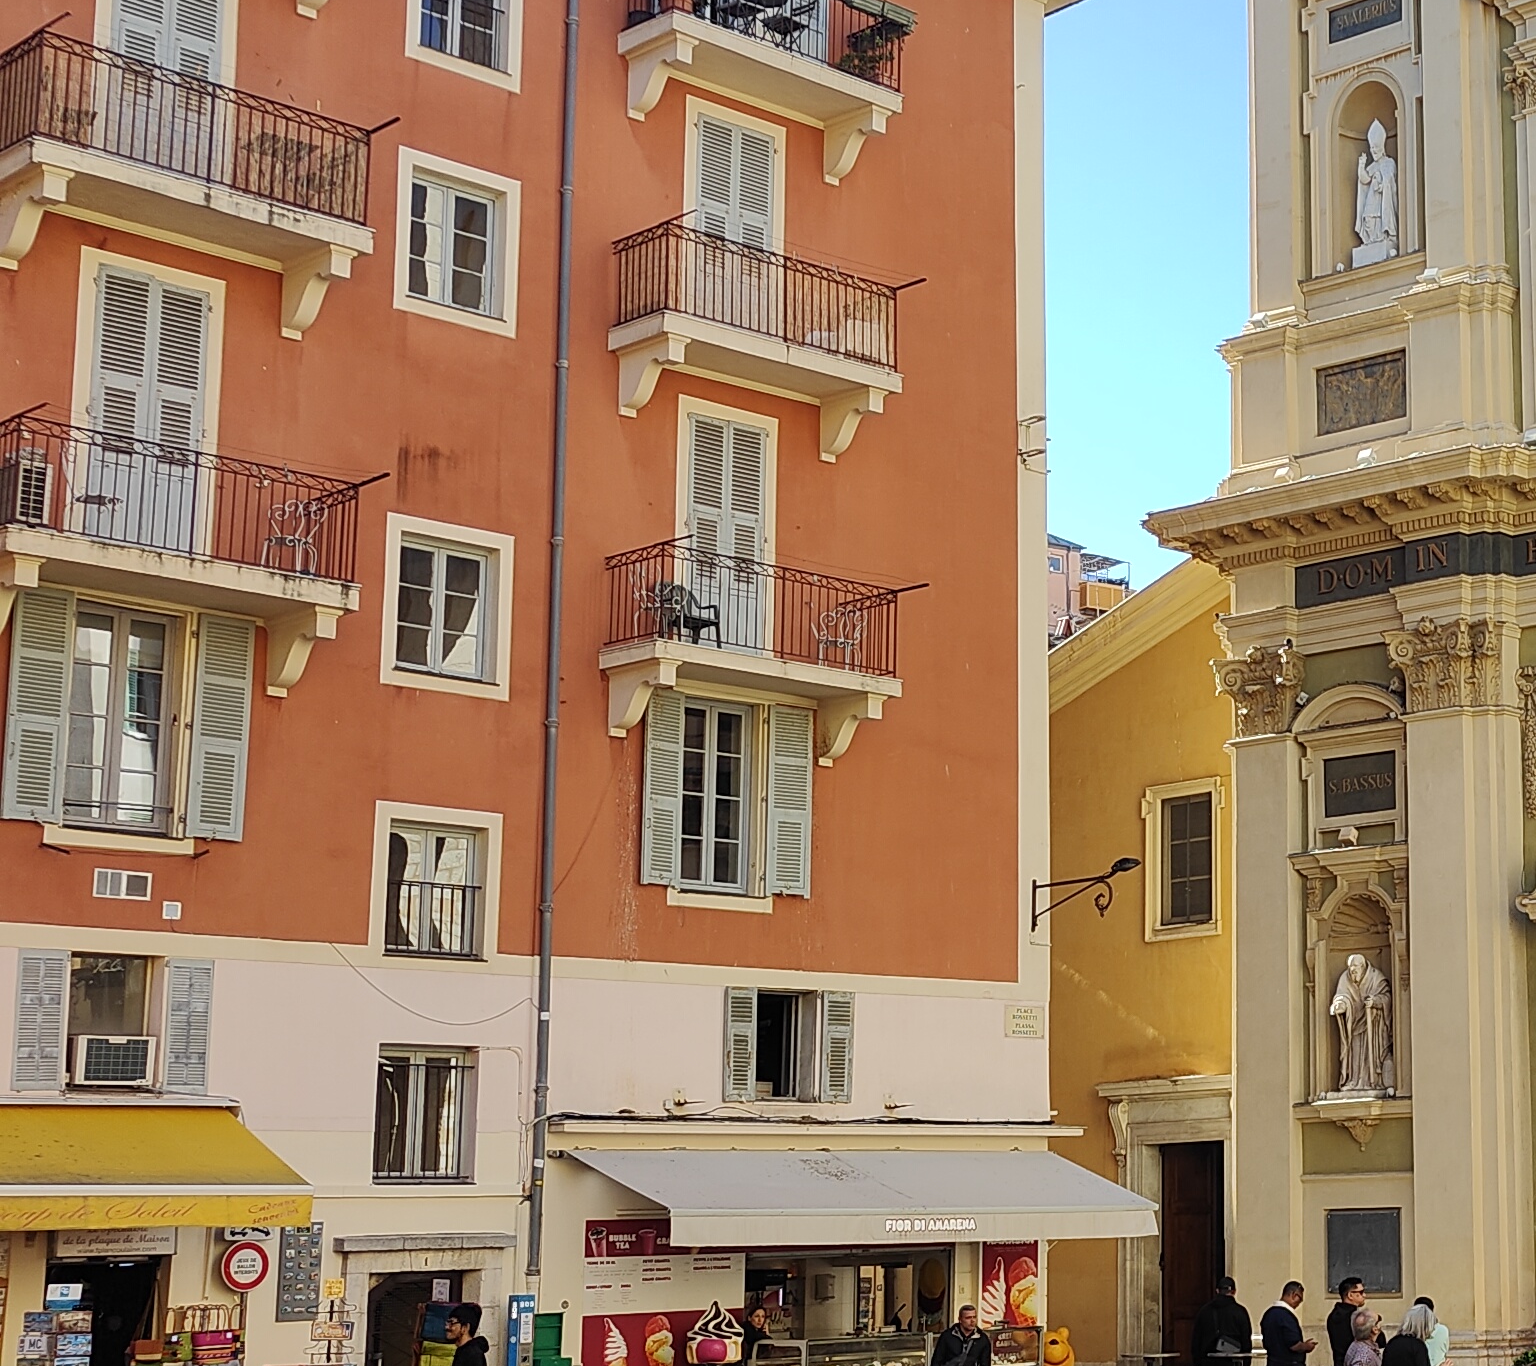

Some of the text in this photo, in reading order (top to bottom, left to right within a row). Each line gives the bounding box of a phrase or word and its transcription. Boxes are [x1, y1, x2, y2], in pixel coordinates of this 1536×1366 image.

[1416, 541, 1448, 572] IN
[0, 1201, 198, 1227] oup de Soleil
[885, 1217, 977, 1233] FIOR DI AMARENA
[608, 1234, 637, 1242] BUBBLE
[615, 1241, 630, 1250] TEA
[28, 1338, 42, 1349] MC
